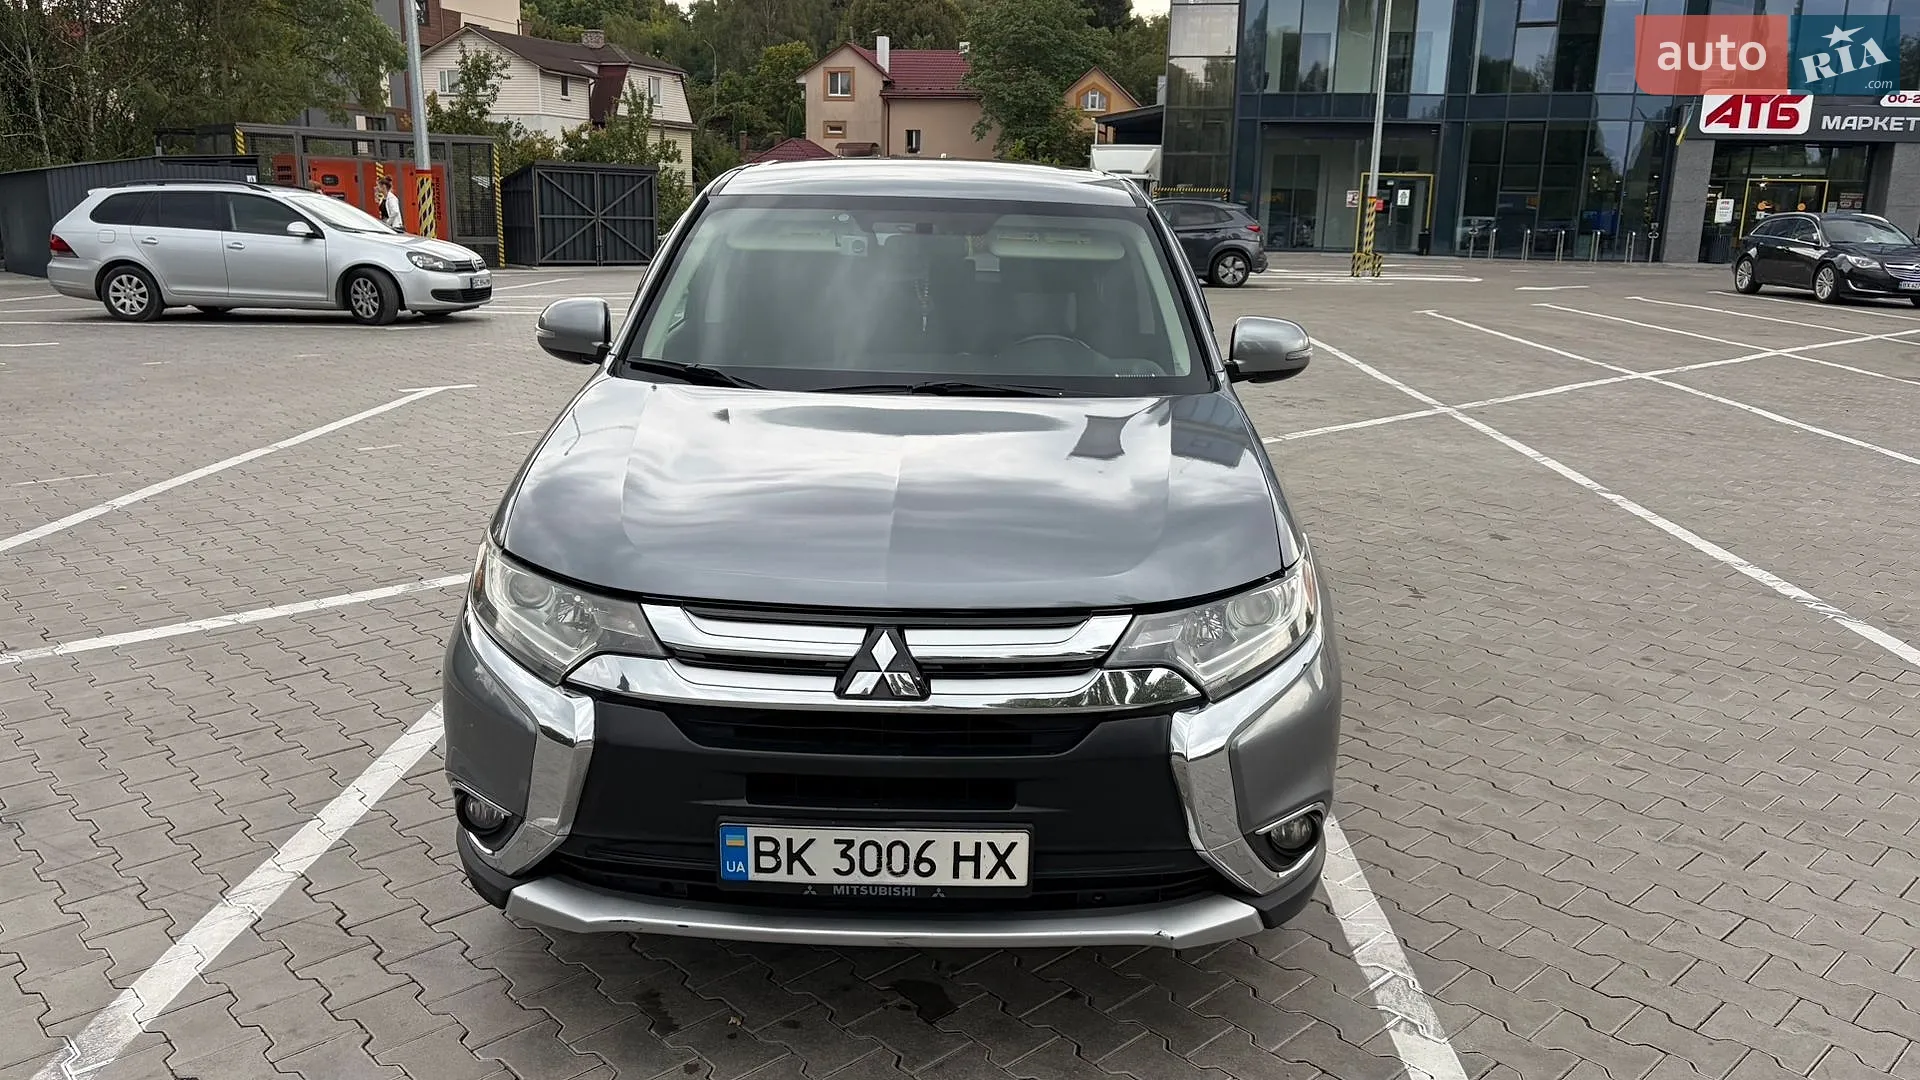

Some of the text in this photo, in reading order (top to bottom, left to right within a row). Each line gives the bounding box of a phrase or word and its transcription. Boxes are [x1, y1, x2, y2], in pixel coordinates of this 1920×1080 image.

[1705, 94, 1807, 129] АТБ
[1821, 116, 1920, 131] МАРКЕТ
[753, 835, 1018, 880] BK 3006 HX
[726, 861, 746, 873] UA
[832, 885, 916, 897] MITSUBISHI
